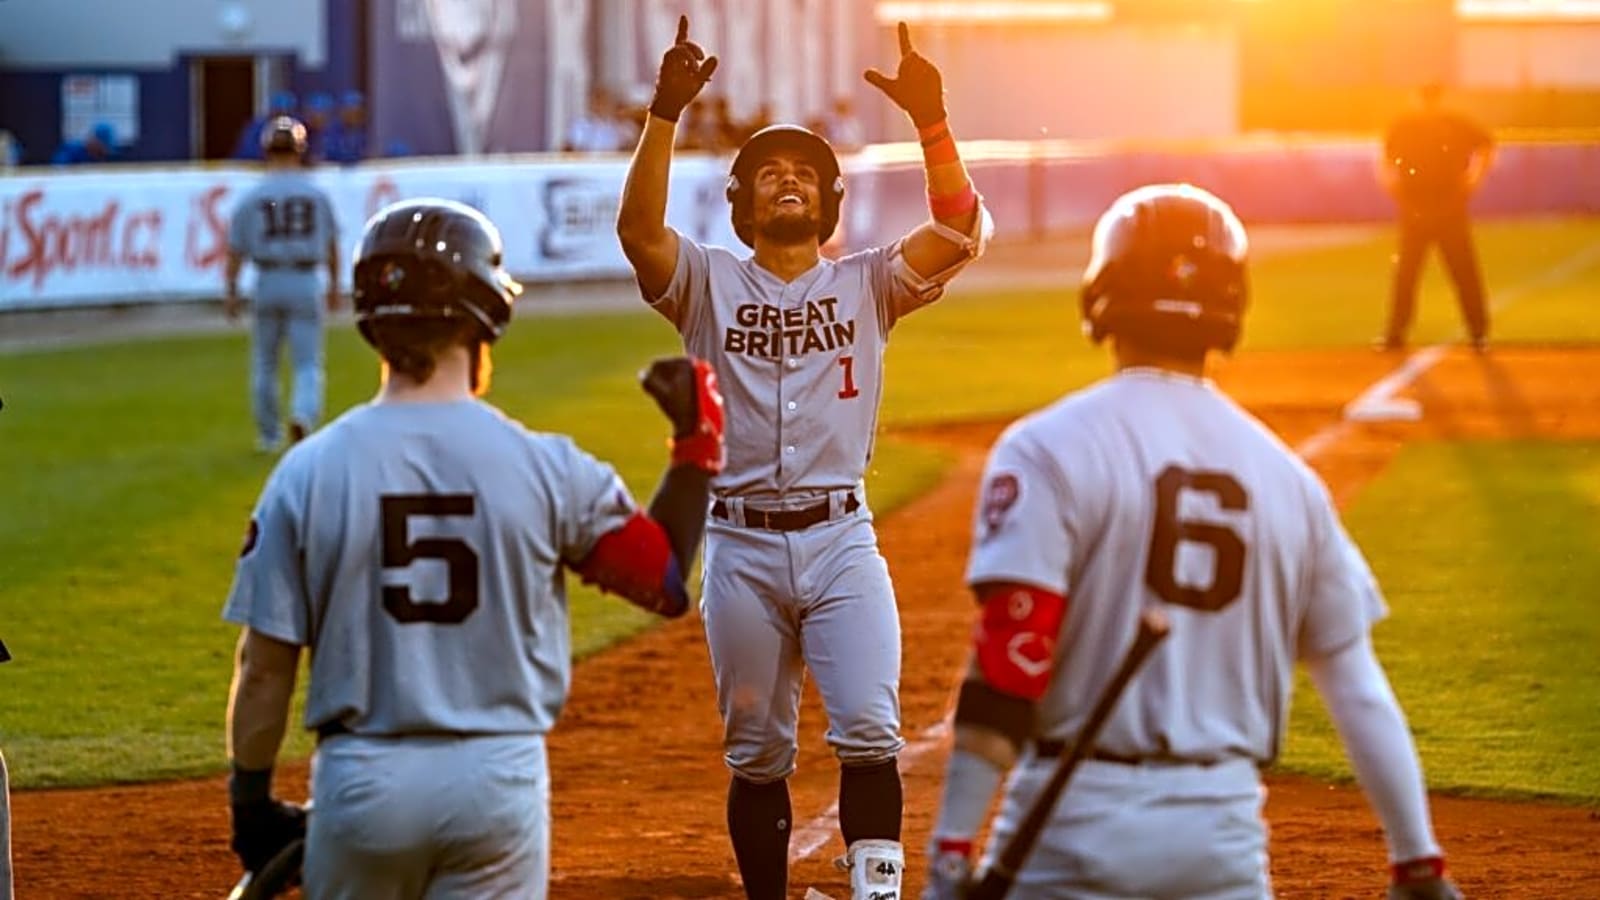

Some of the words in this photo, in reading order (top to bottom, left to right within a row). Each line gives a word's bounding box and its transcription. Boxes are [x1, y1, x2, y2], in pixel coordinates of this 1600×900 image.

[261, 198, 317, 239] 18
[735, 296, 838, 330] GREAT
[724, 319, 856, 358] BRITAIN
[837, 356, 859, 400] 1
[380, 494, 479, 624] 5
[1146, 465, 1249, 614] 6
